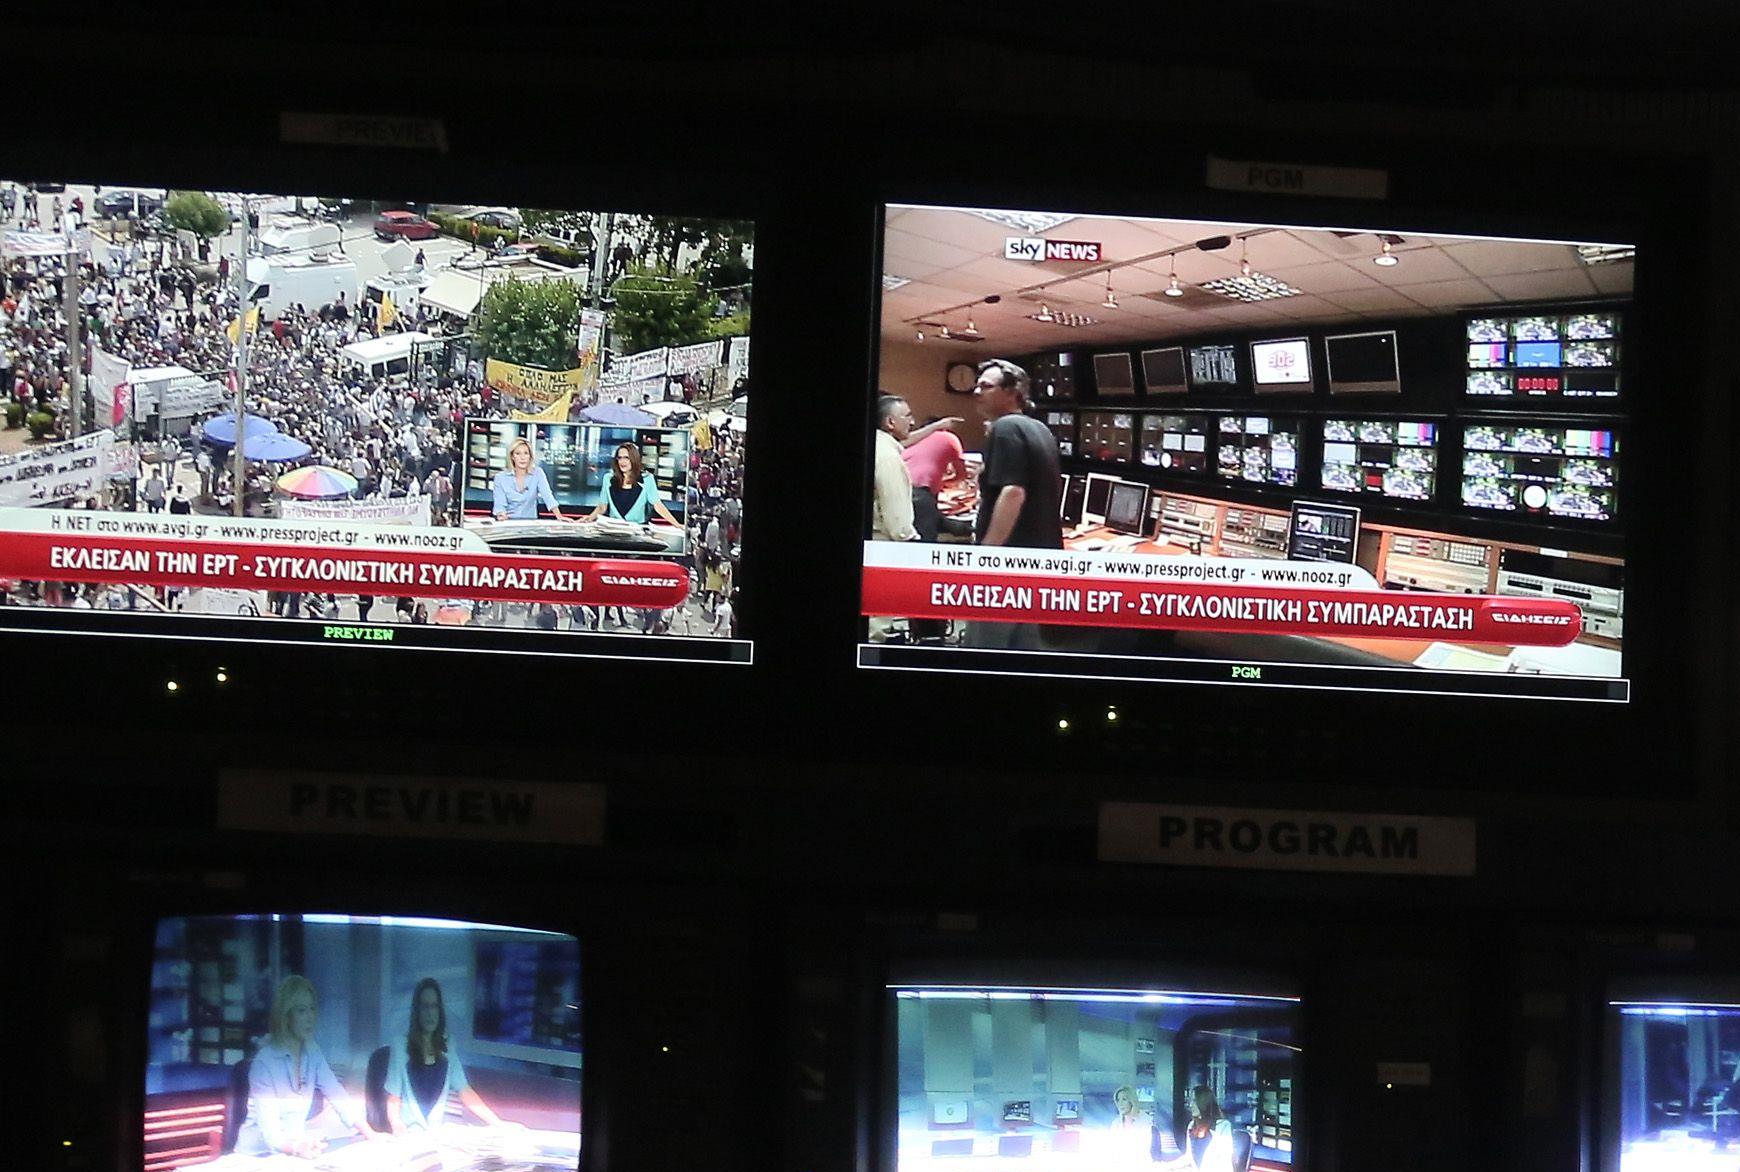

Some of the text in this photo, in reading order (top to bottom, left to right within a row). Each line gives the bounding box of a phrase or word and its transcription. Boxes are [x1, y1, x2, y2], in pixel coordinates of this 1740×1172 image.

[1247, 166, 1304, 190] PGM
[1009, 238, 1099, 261] sky NEWS
[97, 520, 120, 533] στο
[123, 521, 209, 539] www.avgi.gr
[374, 532, 464, 550] www.nooz.gr
[50, 546, 151, 573] ΕΚΛΕΙΣΑΝ
[156, 551, 198, 575] ΤΗΝ
[203, 554, 240, 577] ΕΡΤ
[254, 556, 415, 584] ΣΥΓΚΛΟΝΙΣΤΙΚΗ
[418, 563, 583, 593] ΣΥΜΠΑΡΑΣΤΑΣΗ
[978, 555, 1001, 569] στο
[1004, 556, 1092, 575] www.avgi.gr
[1261, 567, 1352, 587] www.nooz.gr
[930, 582, 1033, 609] ΕΚΛΕΙΣΑΝ
[1038, 588, 1081, 612] ΤΗΝ
[1086, 591, 1124, 614] ΕΡΤ
[1138, 592, 1302, 622] ΣΥΓΚΛΟΝΙΣΤΙΚΗ
[1307, 600, 1474, 631] ΣΥΜΠΑΡΑΣΤΑΣΗ
[323, 626, 395, 641] PREVIEW
[1231, 665, 1262, 680] PGM
[289, 782, 536, 826] PREVIEW
[1159, 816, 1419, 860] PROGRAM
